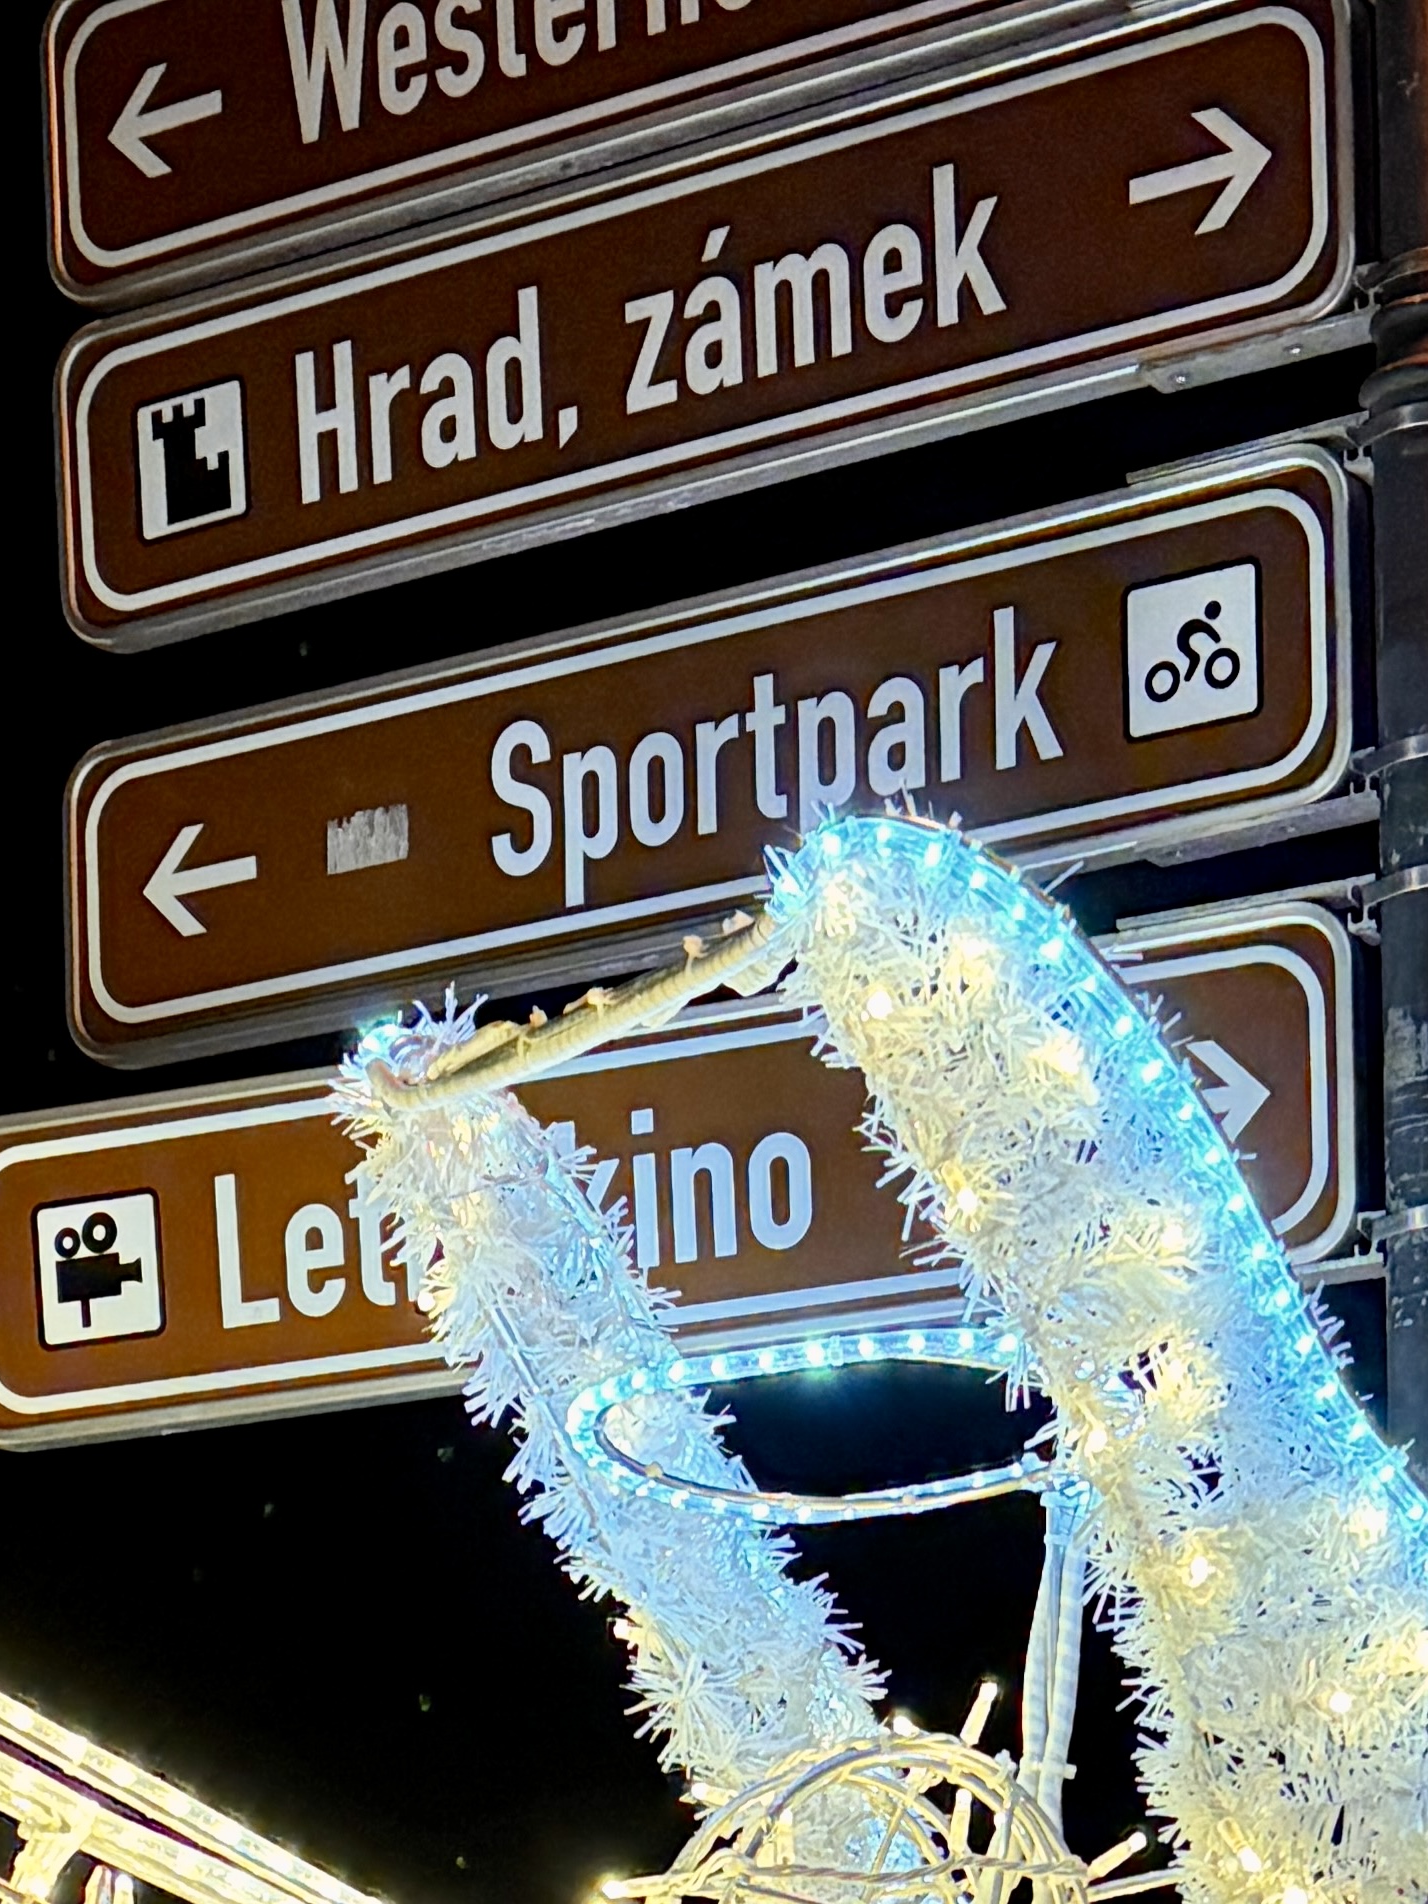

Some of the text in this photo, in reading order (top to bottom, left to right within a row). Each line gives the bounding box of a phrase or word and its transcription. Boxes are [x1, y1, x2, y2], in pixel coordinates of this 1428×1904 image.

[294, 162, 1007, 505] Hrad, zámek
[490, 605, 1065, 909] Sportpark
